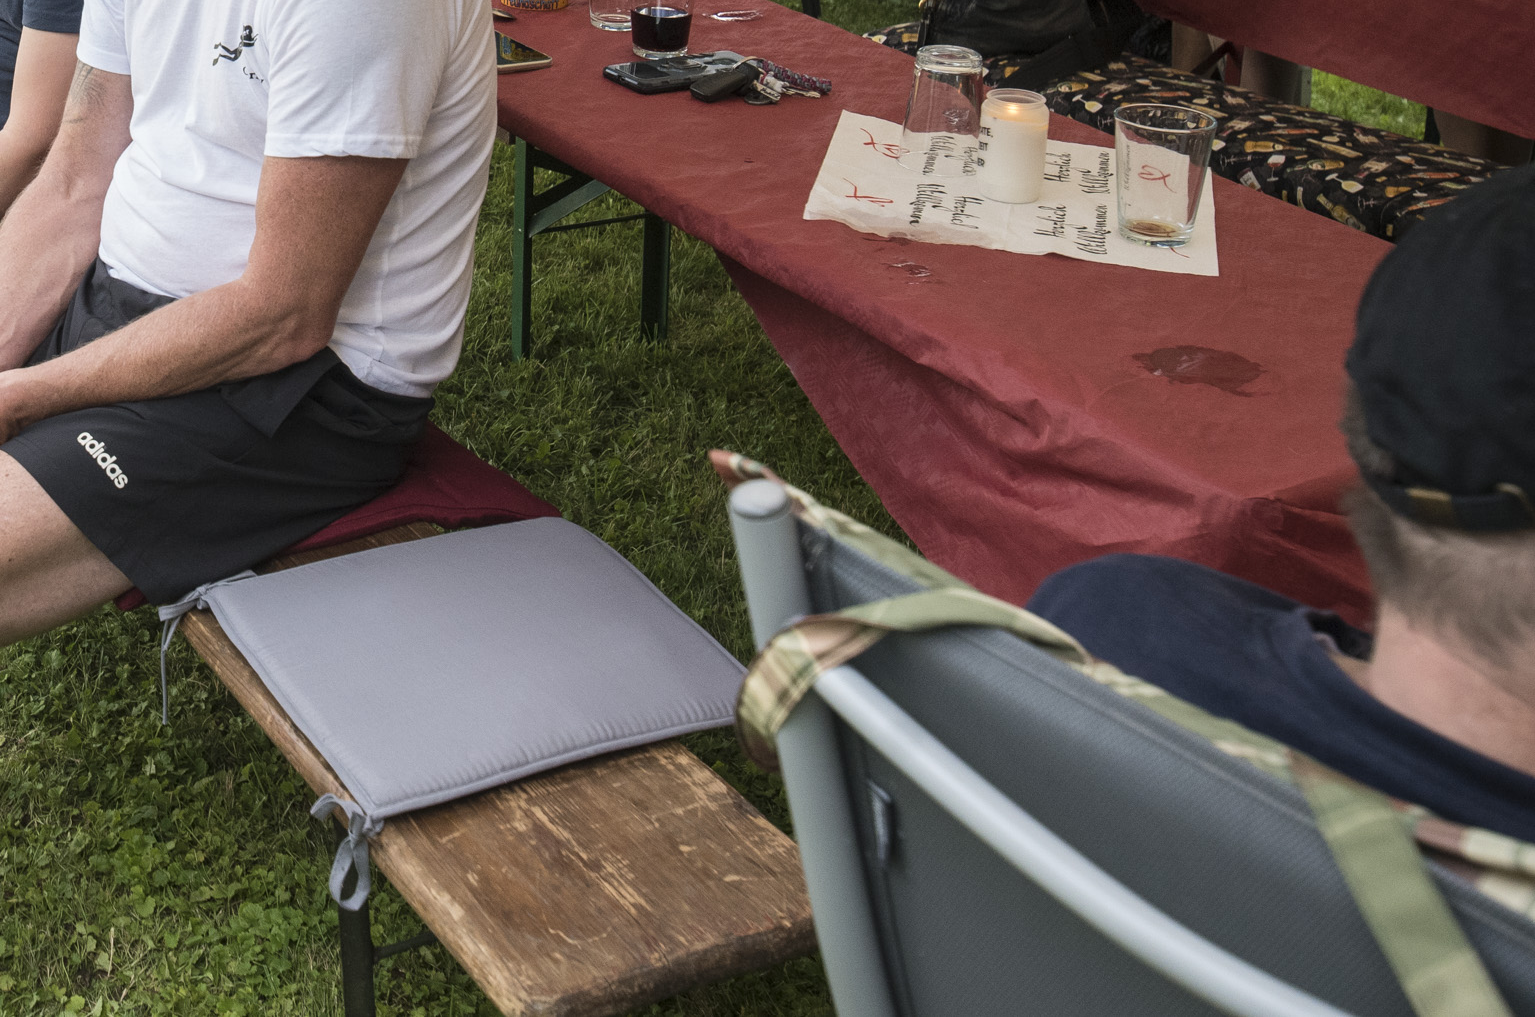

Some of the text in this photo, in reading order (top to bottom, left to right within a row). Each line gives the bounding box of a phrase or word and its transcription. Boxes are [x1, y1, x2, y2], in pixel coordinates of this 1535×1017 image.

[1044, 152, 1091, 182] Herzlich
[1078, 151, 1114, 194] Willkommen
[1033, 204, 1087, 239] Herzlich
[1074, 204, 1111, 254] Willkommen
[77, 432, 128, 489] adidas
